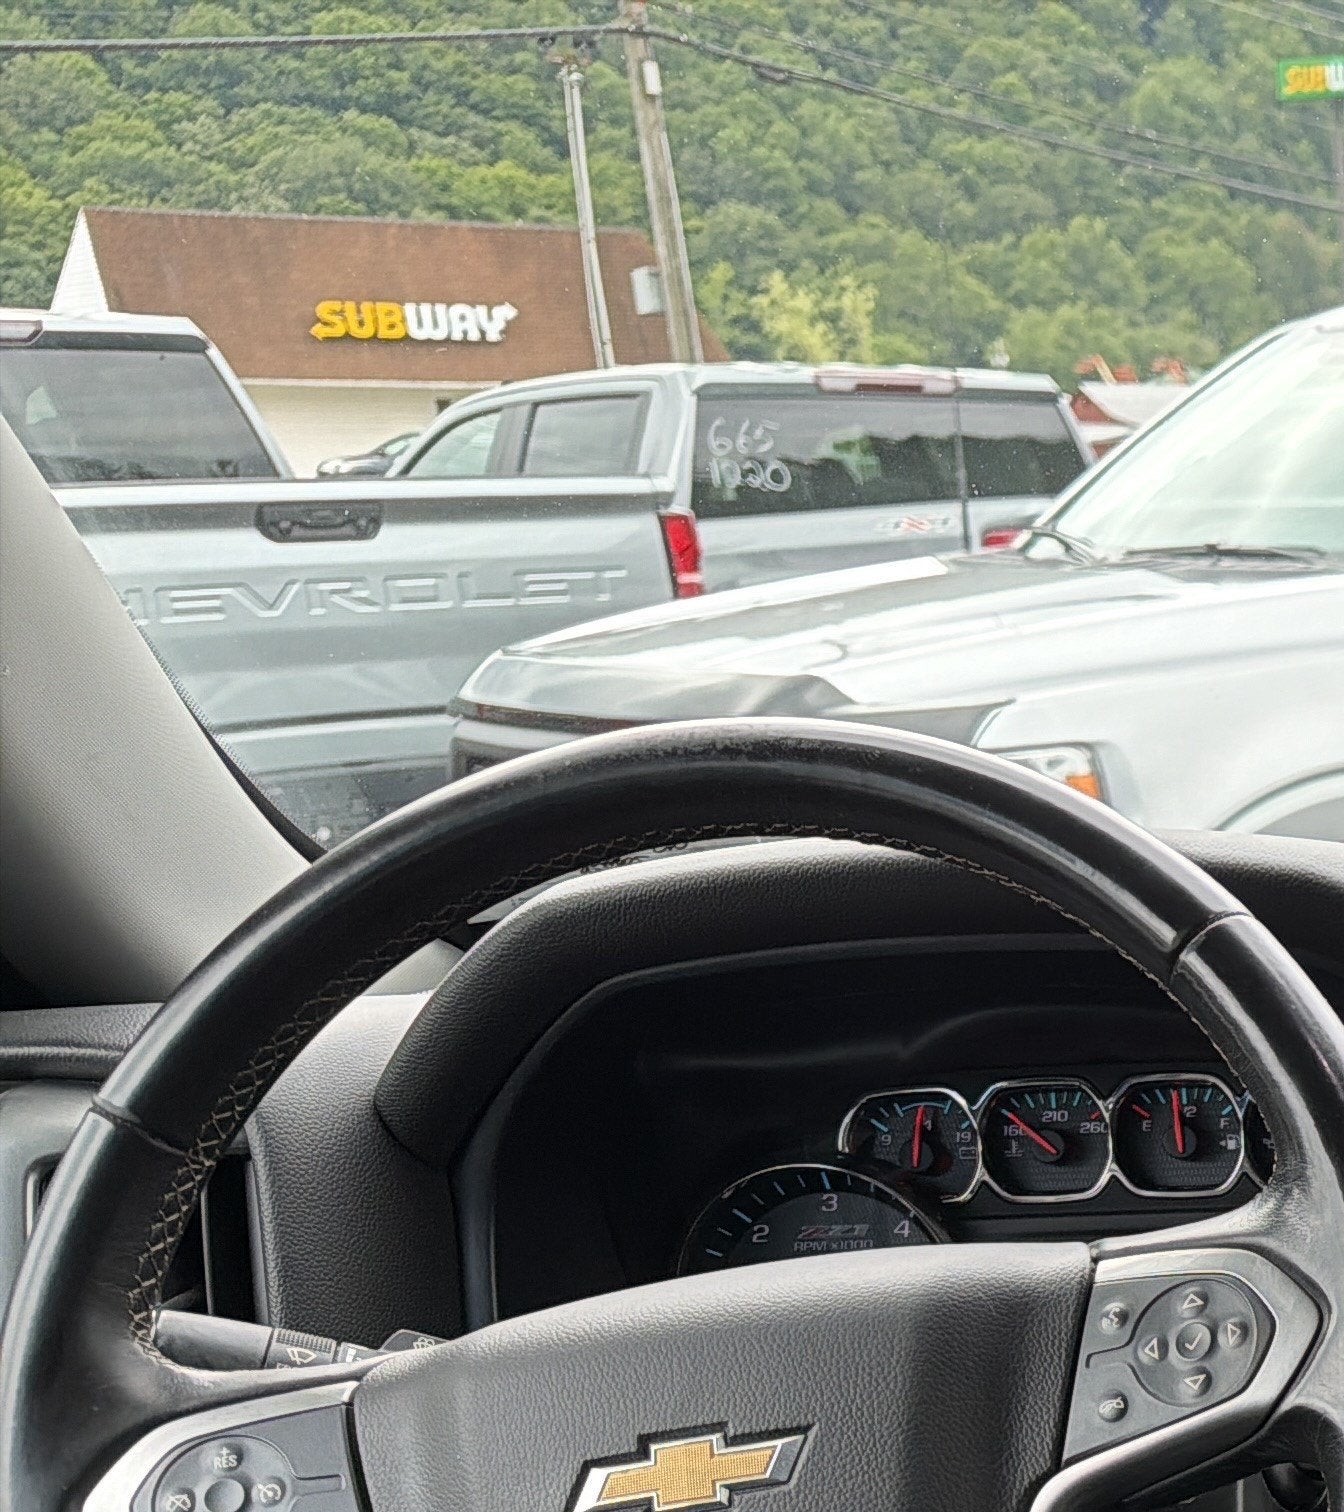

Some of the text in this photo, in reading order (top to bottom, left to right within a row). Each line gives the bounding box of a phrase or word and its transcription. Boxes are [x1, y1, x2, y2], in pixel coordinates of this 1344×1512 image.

[309, 300, 518, 342] SUBWAY
[1041, 1110, 1069, 1123] 210
[1220, 1117, 1230, 1130] F
[1142, 1120, 1151, 1132] E
[881, 1134, 892, 1146] 9
[956, 1131, 972, 1143] 19
[820, 1193, 838, 1212] 3
[752, 1224, 770, 1243] 2
[893, 1219, 911, 1238] 4
[213, 1454, 239, 1470] RES
